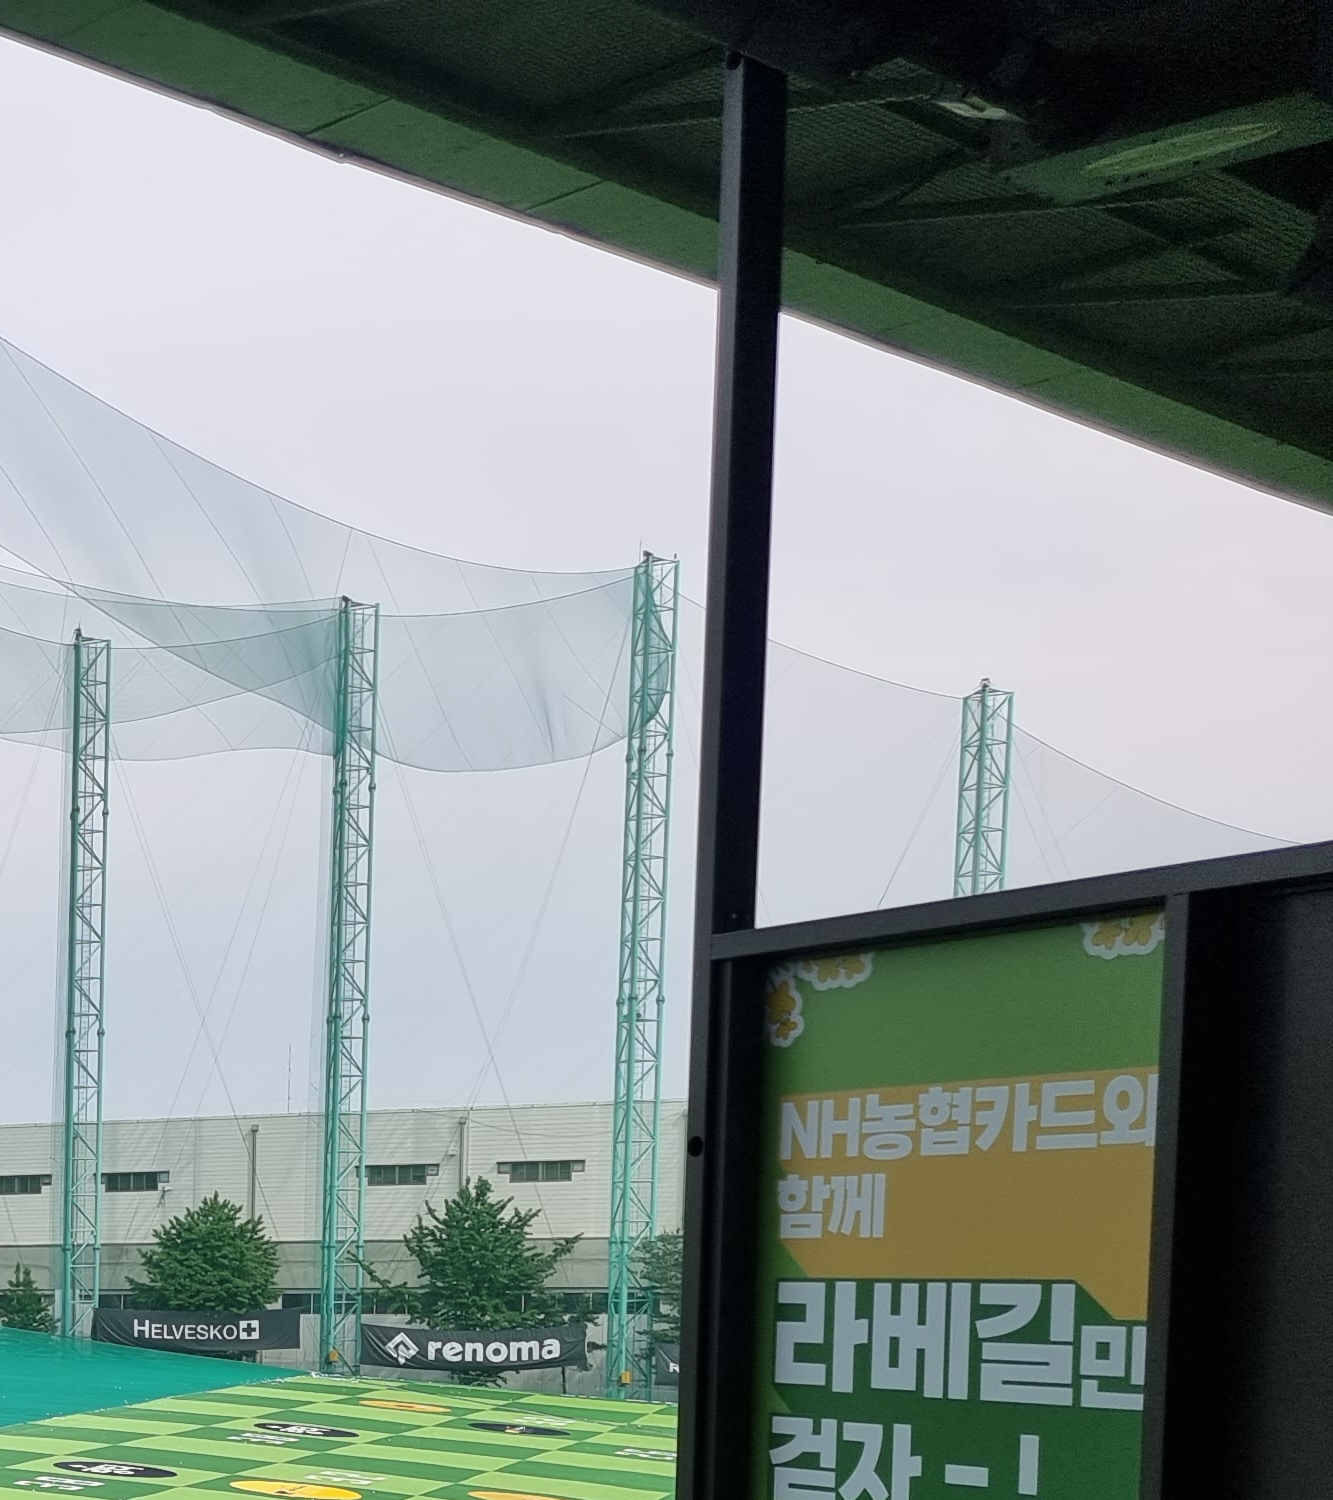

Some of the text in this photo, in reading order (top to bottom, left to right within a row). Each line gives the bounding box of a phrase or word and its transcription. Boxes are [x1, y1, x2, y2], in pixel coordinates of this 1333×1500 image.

[777, 1172, 887, 1239] 함께
[133, 1318, 238, 1340] HELVESKO
[427, 1335, 561, 1363] renoma
